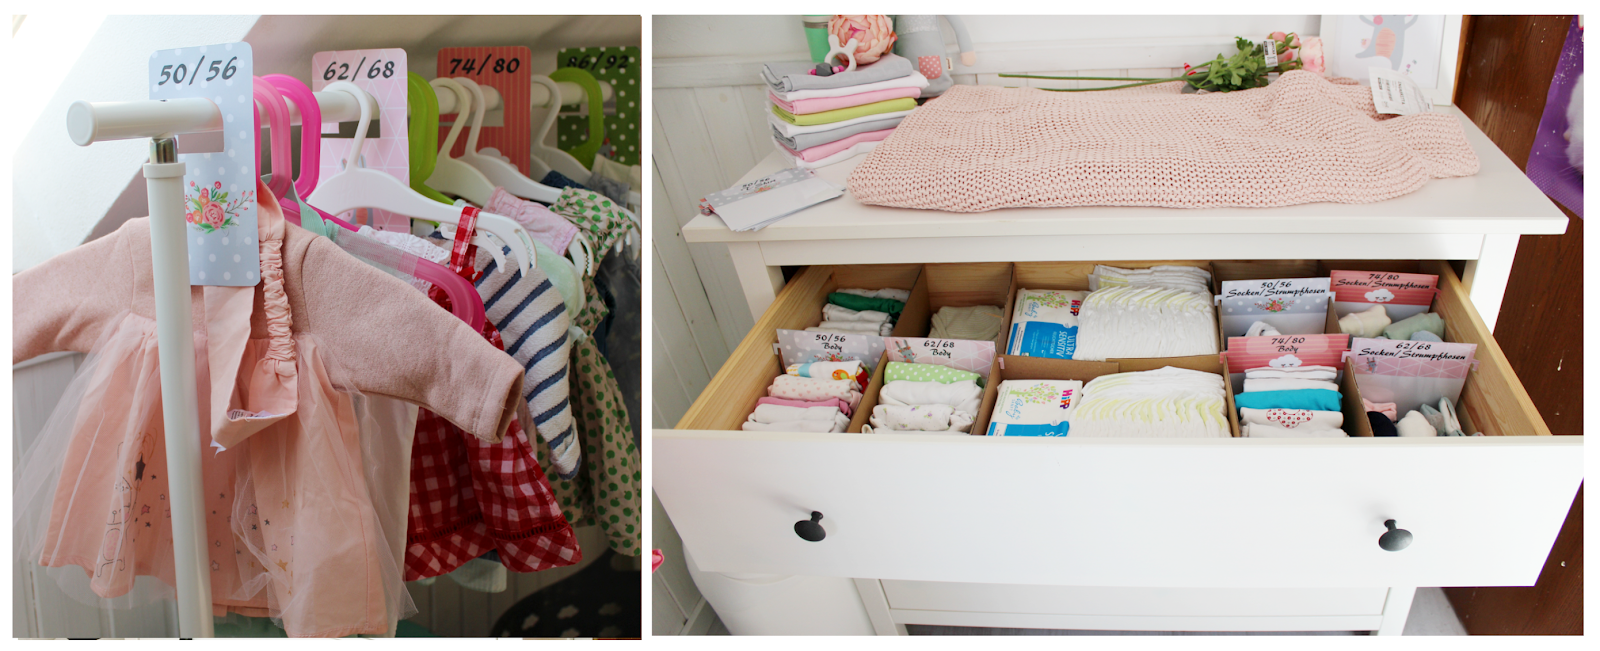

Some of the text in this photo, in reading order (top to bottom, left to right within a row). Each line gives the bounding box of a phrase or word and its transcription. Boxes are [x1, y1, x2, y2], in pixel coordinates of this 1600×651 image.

[449, 53, 520, 76] 74/80
[566, 52, 629, 71] 86/92
[158, 55, 237, 86] 50/56
[323, 57, 395, 81] 62/68
[1261, 281, 1292, 290] 50/56
[1335, 279, 1429, 289] Socken/Strumpfhosen
[1226, 287, 1326, 297] Socken/Strumpfhosen
[815, 333, 846, 343] 50/56
[1271, 337, 1305, 345] 74/80
[822, 343, 843, 352] Body
[924, 340, 955, 349] 62/68
[1056, 331, 1068, 357] SENSITIV
[1066, 335, 1075, 355] ULTRA
[1396, 342, 1431, 351] 62/68
[931, 349, 951, 358] Body
[1276, 345, 1299, 354] Body
[1358, 348, 1466, 361] Socken/Strumpfhosen
[1059, 389, 1073, 409] HiPP
